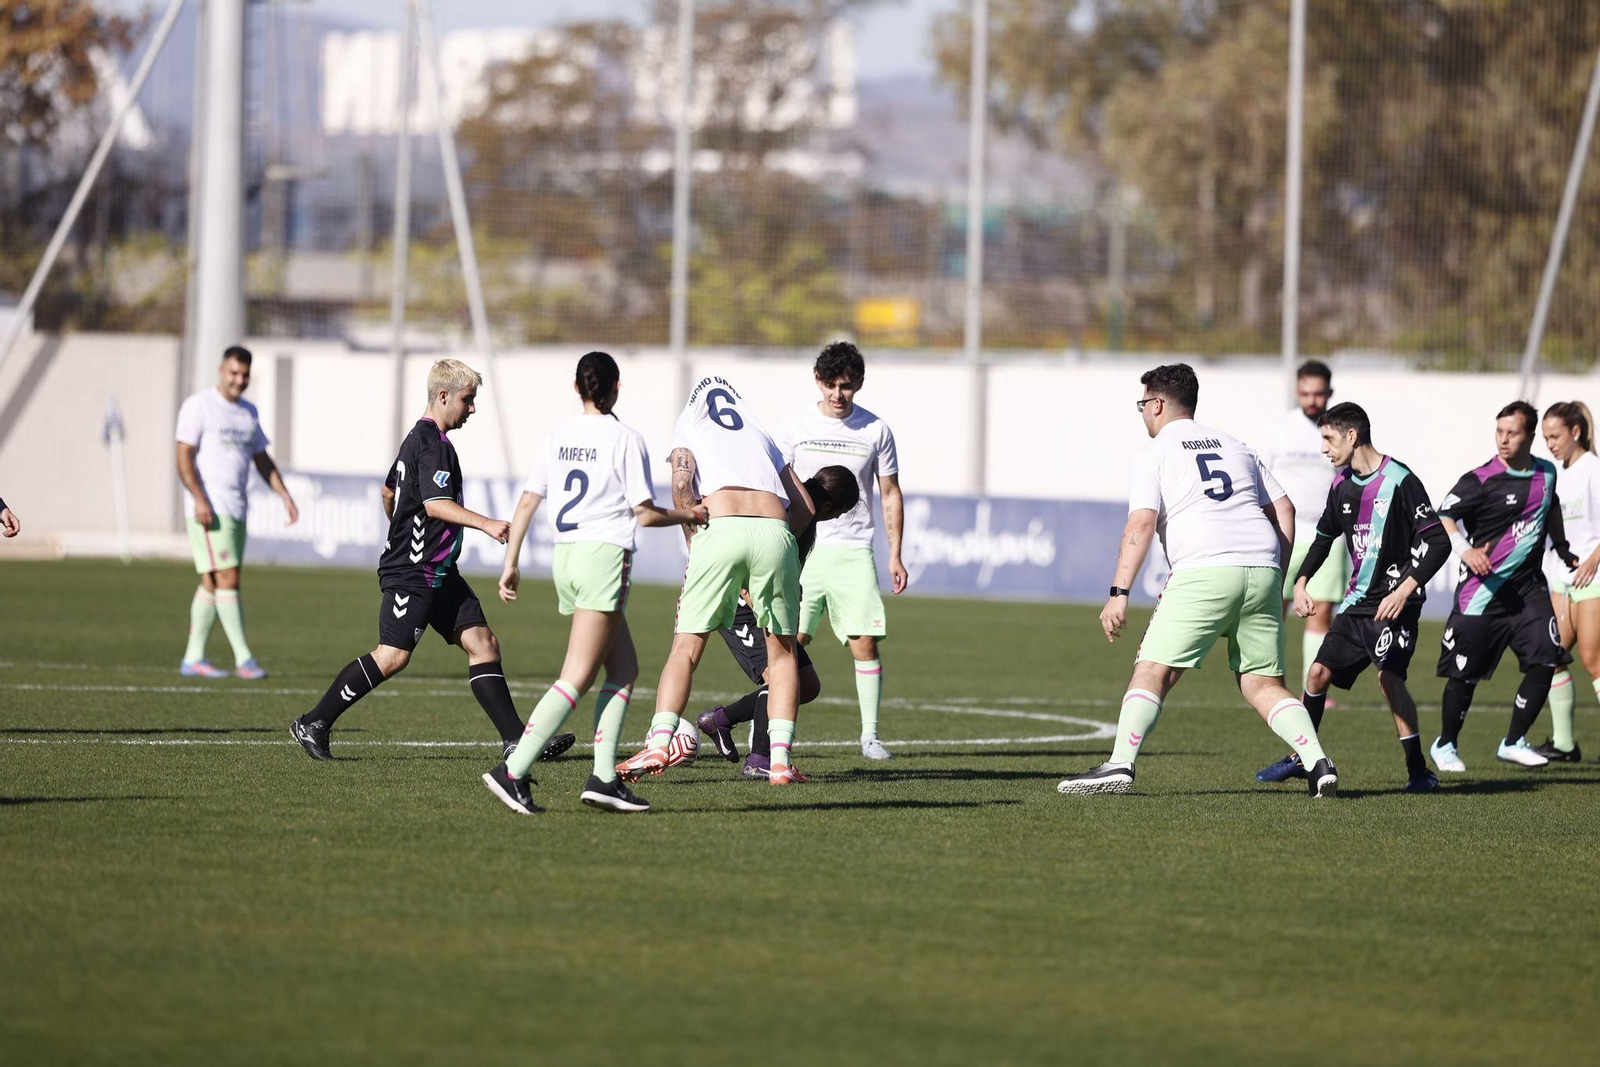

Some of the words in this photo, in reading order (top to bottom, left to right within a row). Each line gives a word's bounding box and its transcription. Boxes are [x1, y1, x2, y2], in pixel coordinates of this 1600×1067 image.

[706, 388, 744, 431] 6
[558, 446, 597, 462] MIREYA
[1181, 437, 1222, 450] ADRIÁN
[1196, 453, 1234, 501] 5
[556, 469, 589, 532] 2
